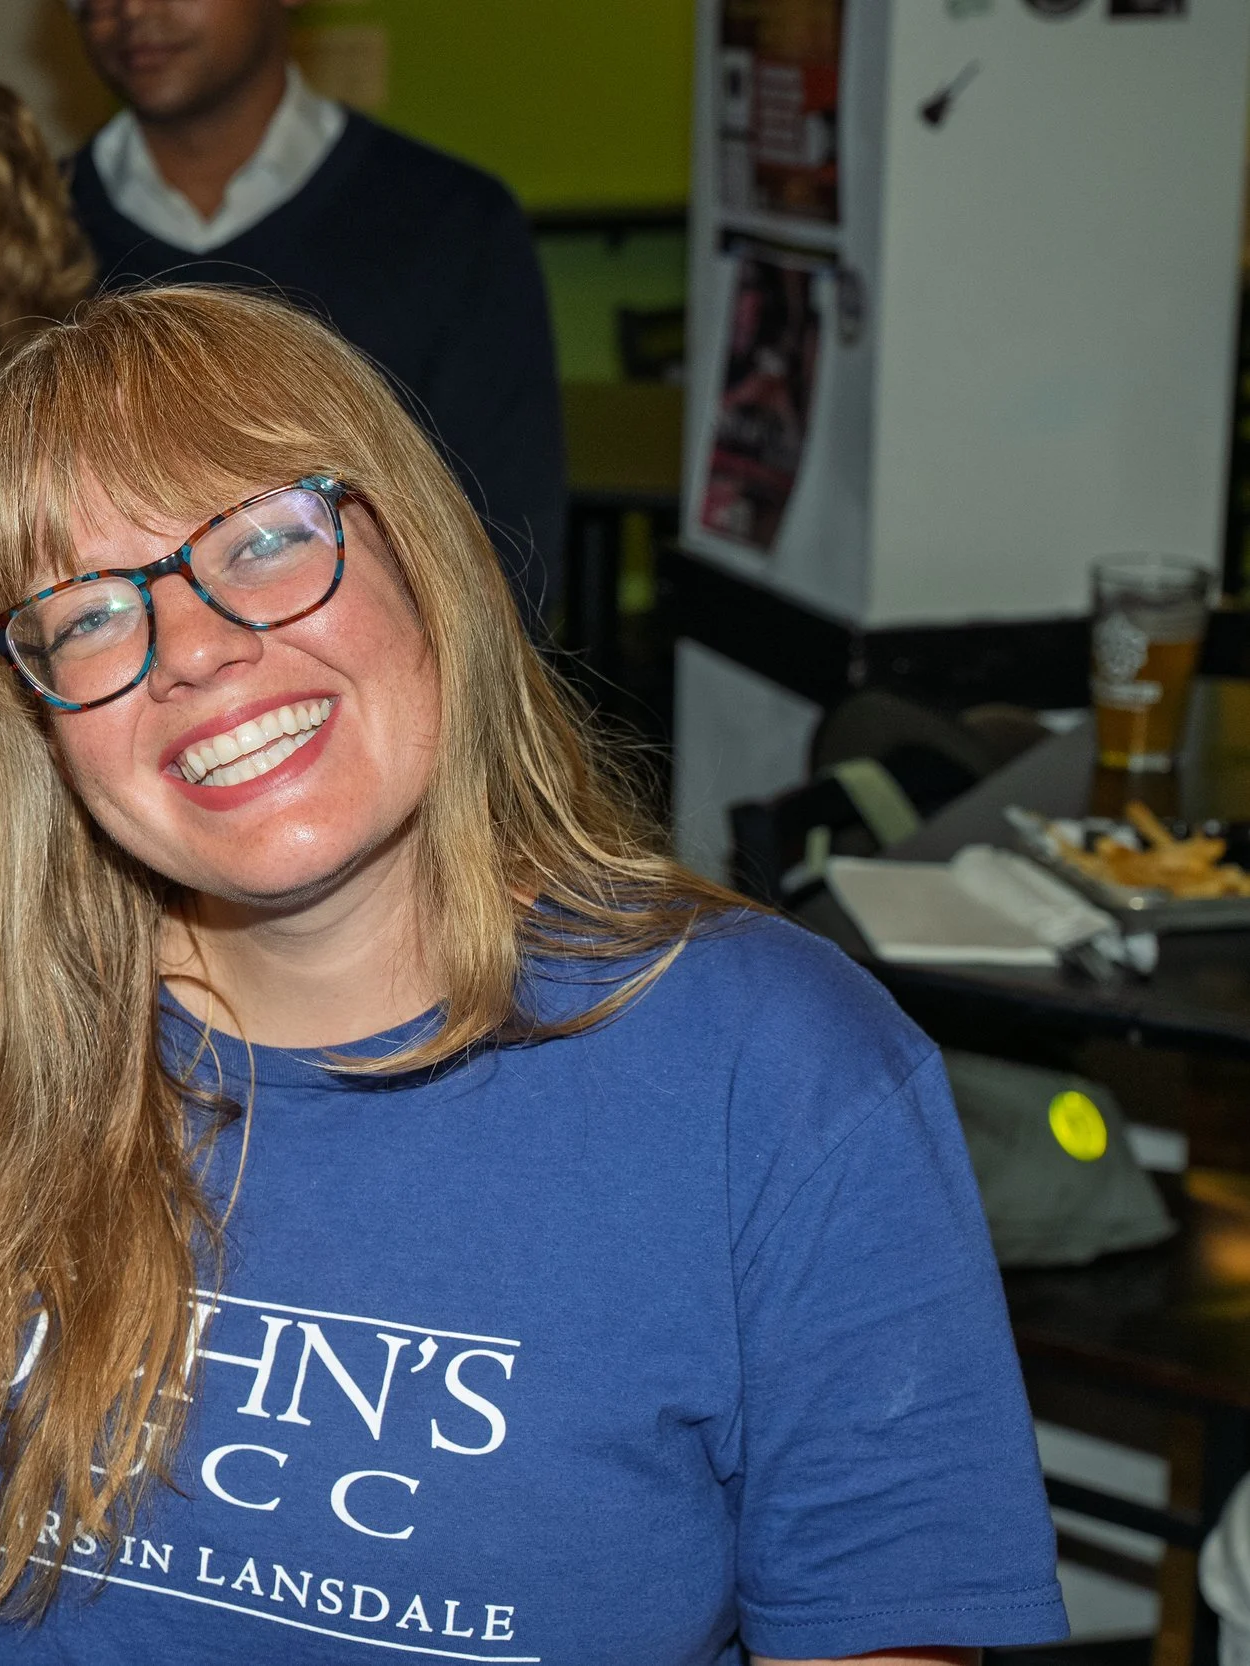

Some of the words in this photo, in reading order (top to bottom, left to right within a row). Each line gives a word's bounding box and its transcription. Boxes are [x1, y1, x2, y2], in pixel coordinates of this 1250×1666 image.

[0, 1300, 516, 1456] HN'S
[119, 1534, 175, 1575] IN
[196, 1545, 515, 1641] LANSDALE
